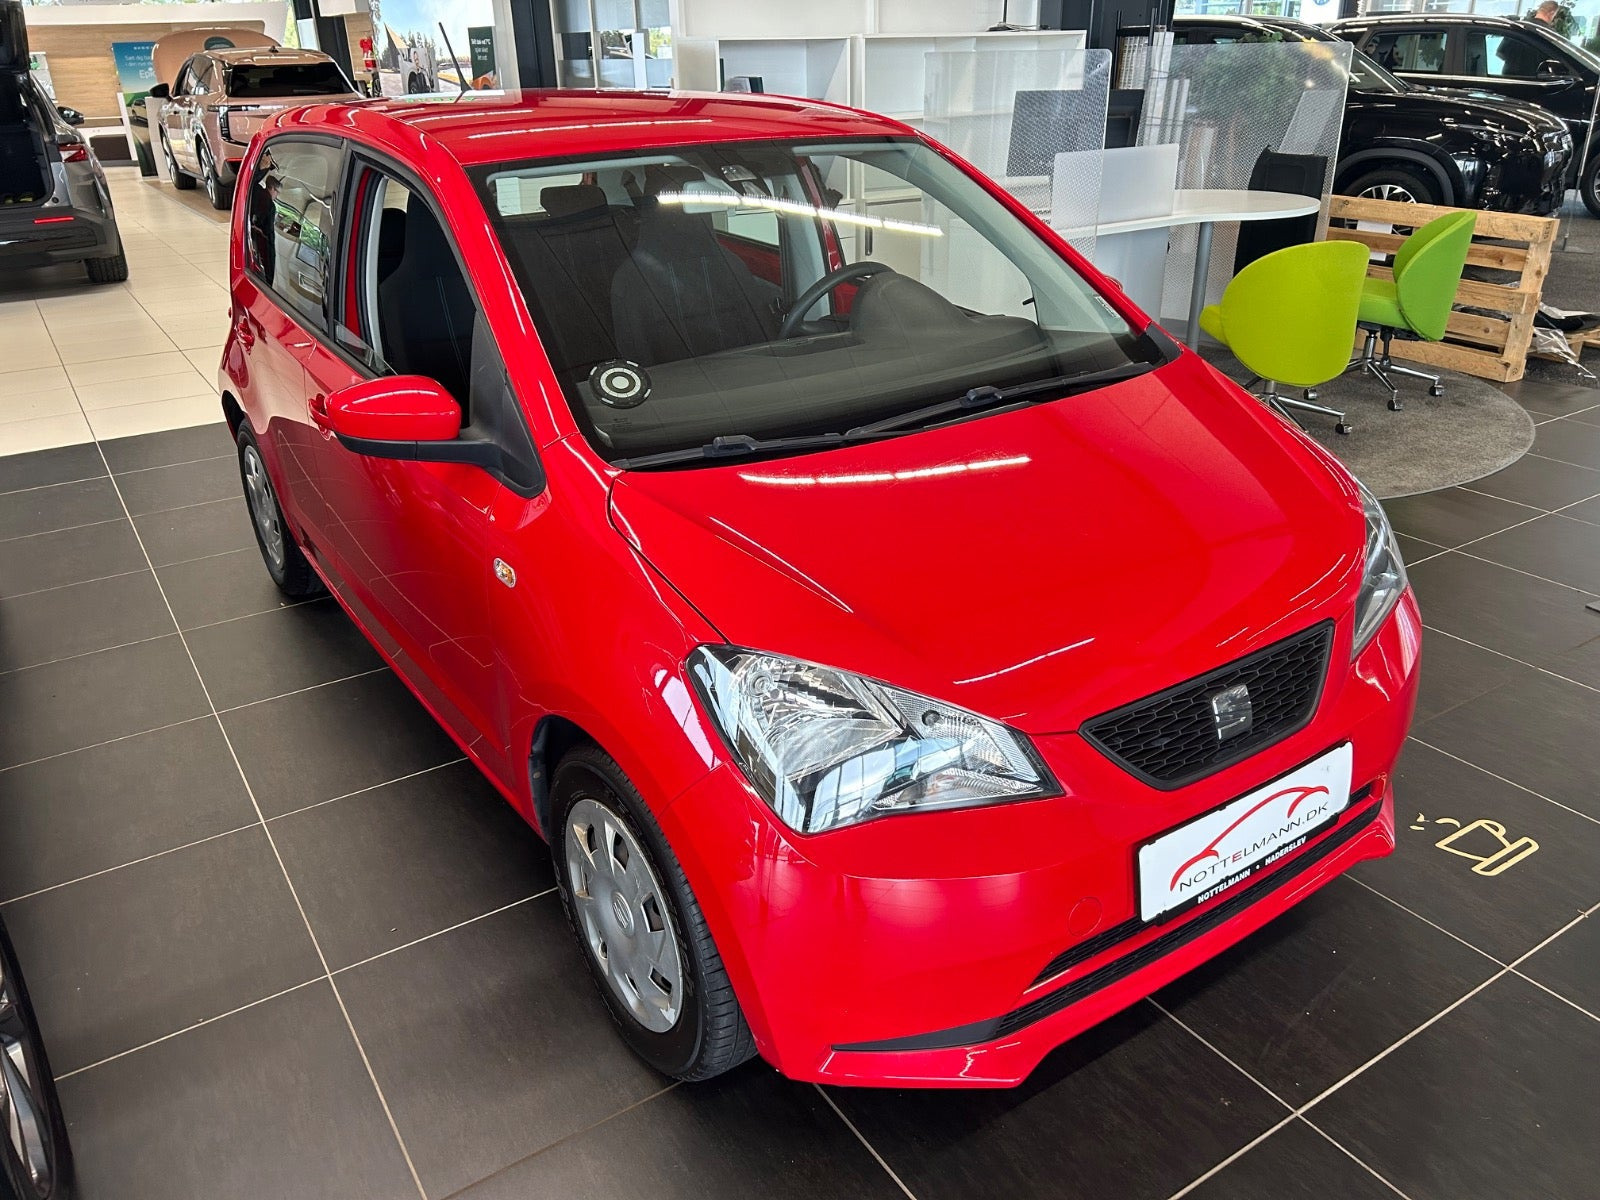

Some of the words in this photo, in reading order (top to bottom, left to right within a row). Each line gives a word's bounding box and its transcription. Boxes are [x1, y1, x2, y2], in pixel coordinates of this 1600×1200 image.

[1179, 801, 1329, 892] NOTTELMANN.DK
[1197, 868, 1251, 904] NOTTELMANN
[1265, 835, 1307, 866] HADERSLEV
